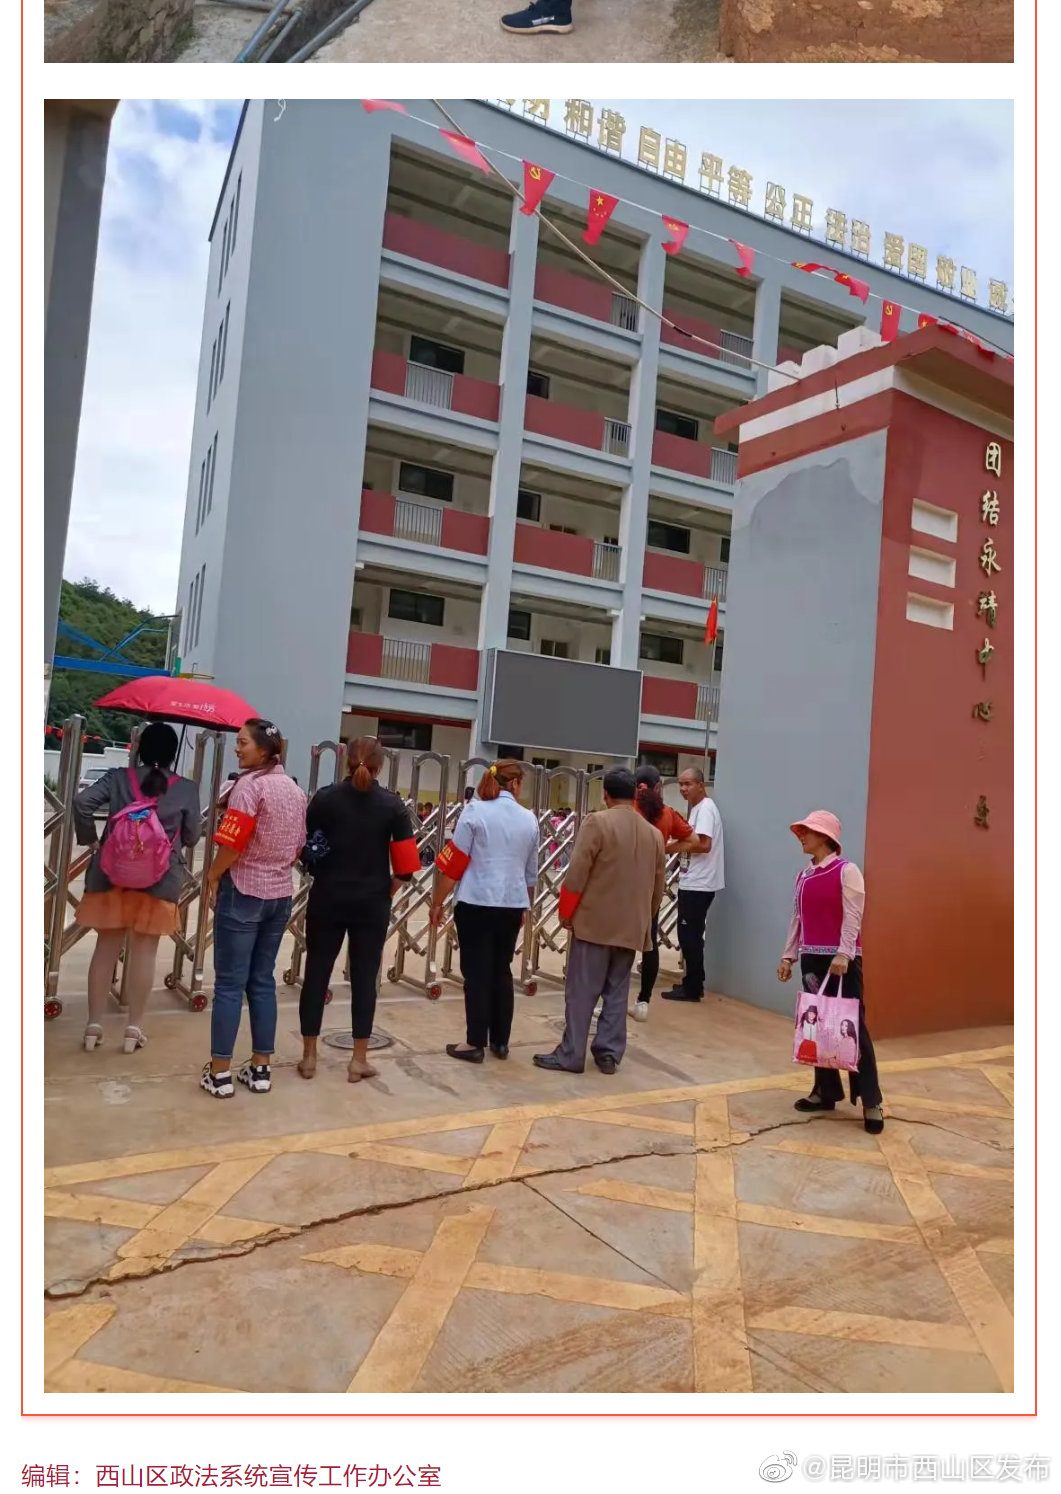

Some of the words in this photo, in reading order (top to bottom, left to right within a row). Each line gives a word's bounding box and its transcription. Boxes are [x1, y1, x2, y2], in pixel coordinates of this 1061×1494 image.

[564, 99, 626, 153] 和谐
[638, 125, 687, 180] 自由
[698, 151, 753, 204] 平等
[764, 180, 813, 230] 公正
